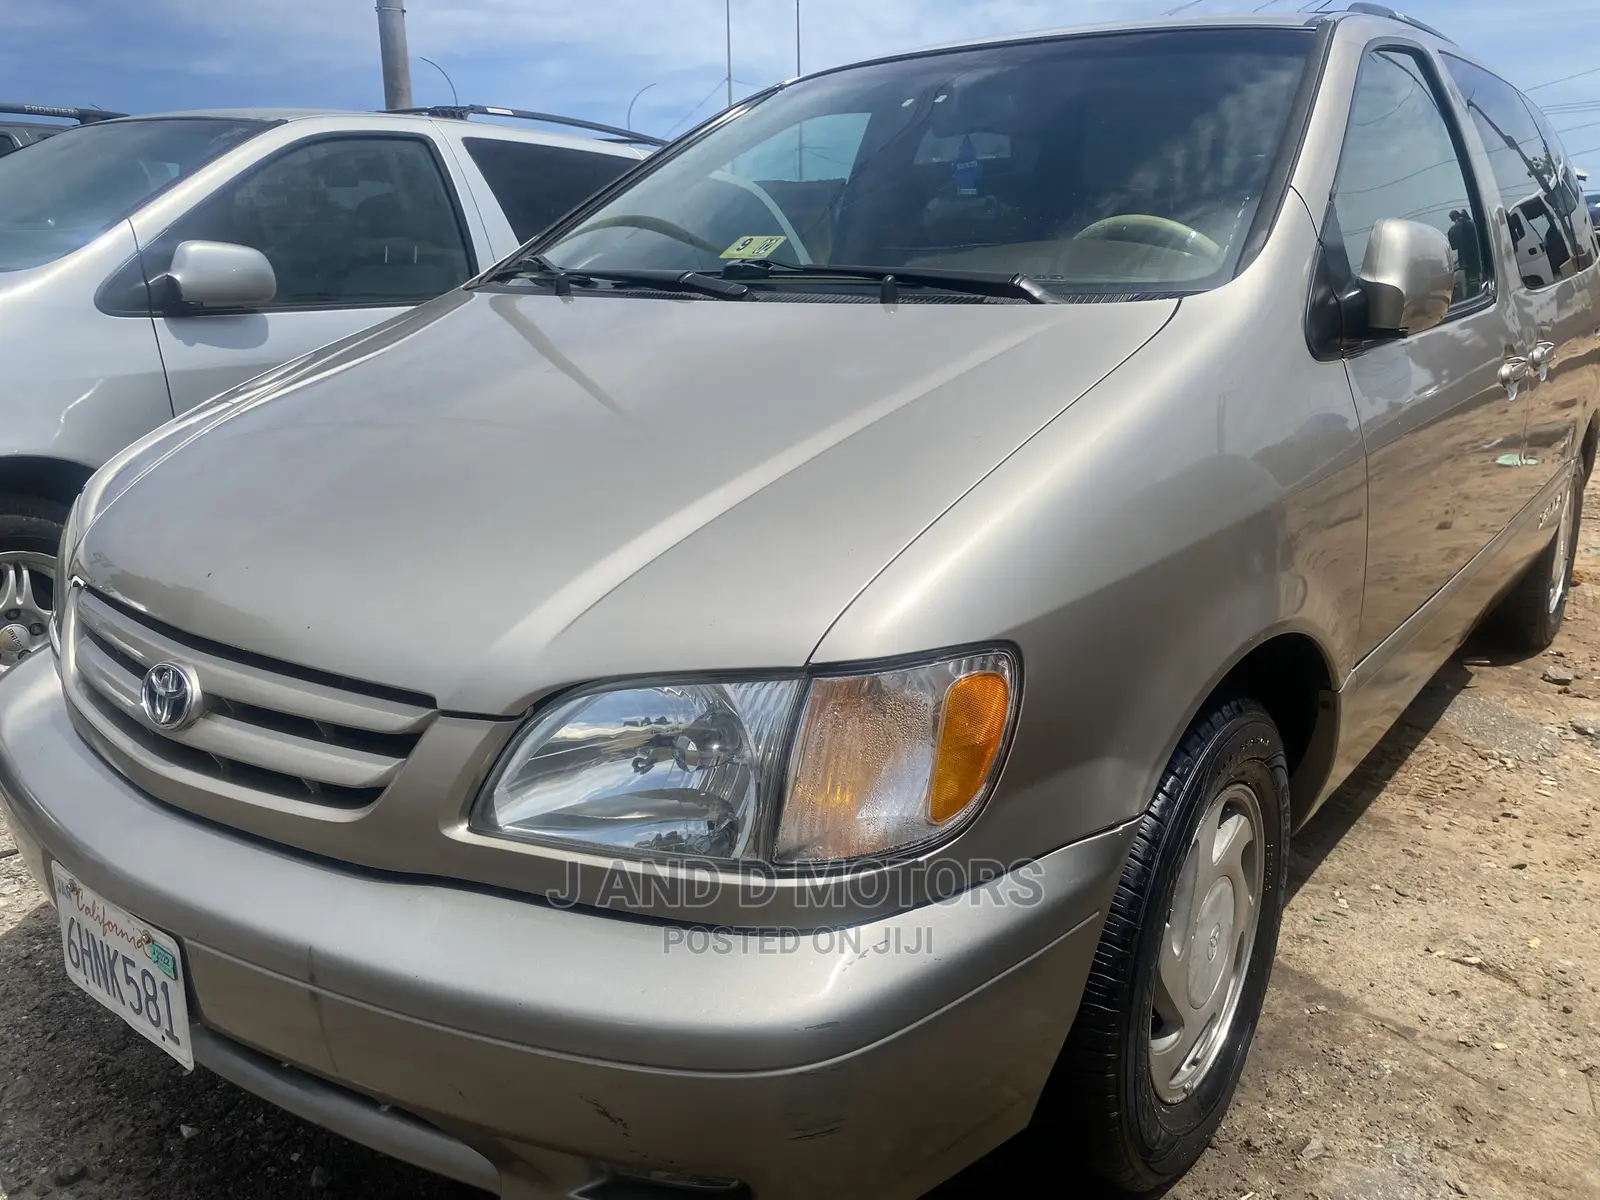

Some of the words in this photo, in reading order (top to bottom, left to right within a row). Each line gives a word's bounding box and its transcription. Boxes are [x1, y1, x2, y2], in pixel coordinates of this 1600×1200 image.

[24, 104, 77, 116] FRONTIER
[736, 238, 754, 251] 9
[72, 886, 147, 950] California
[67, 917, 181, 1046] 6HNK581
